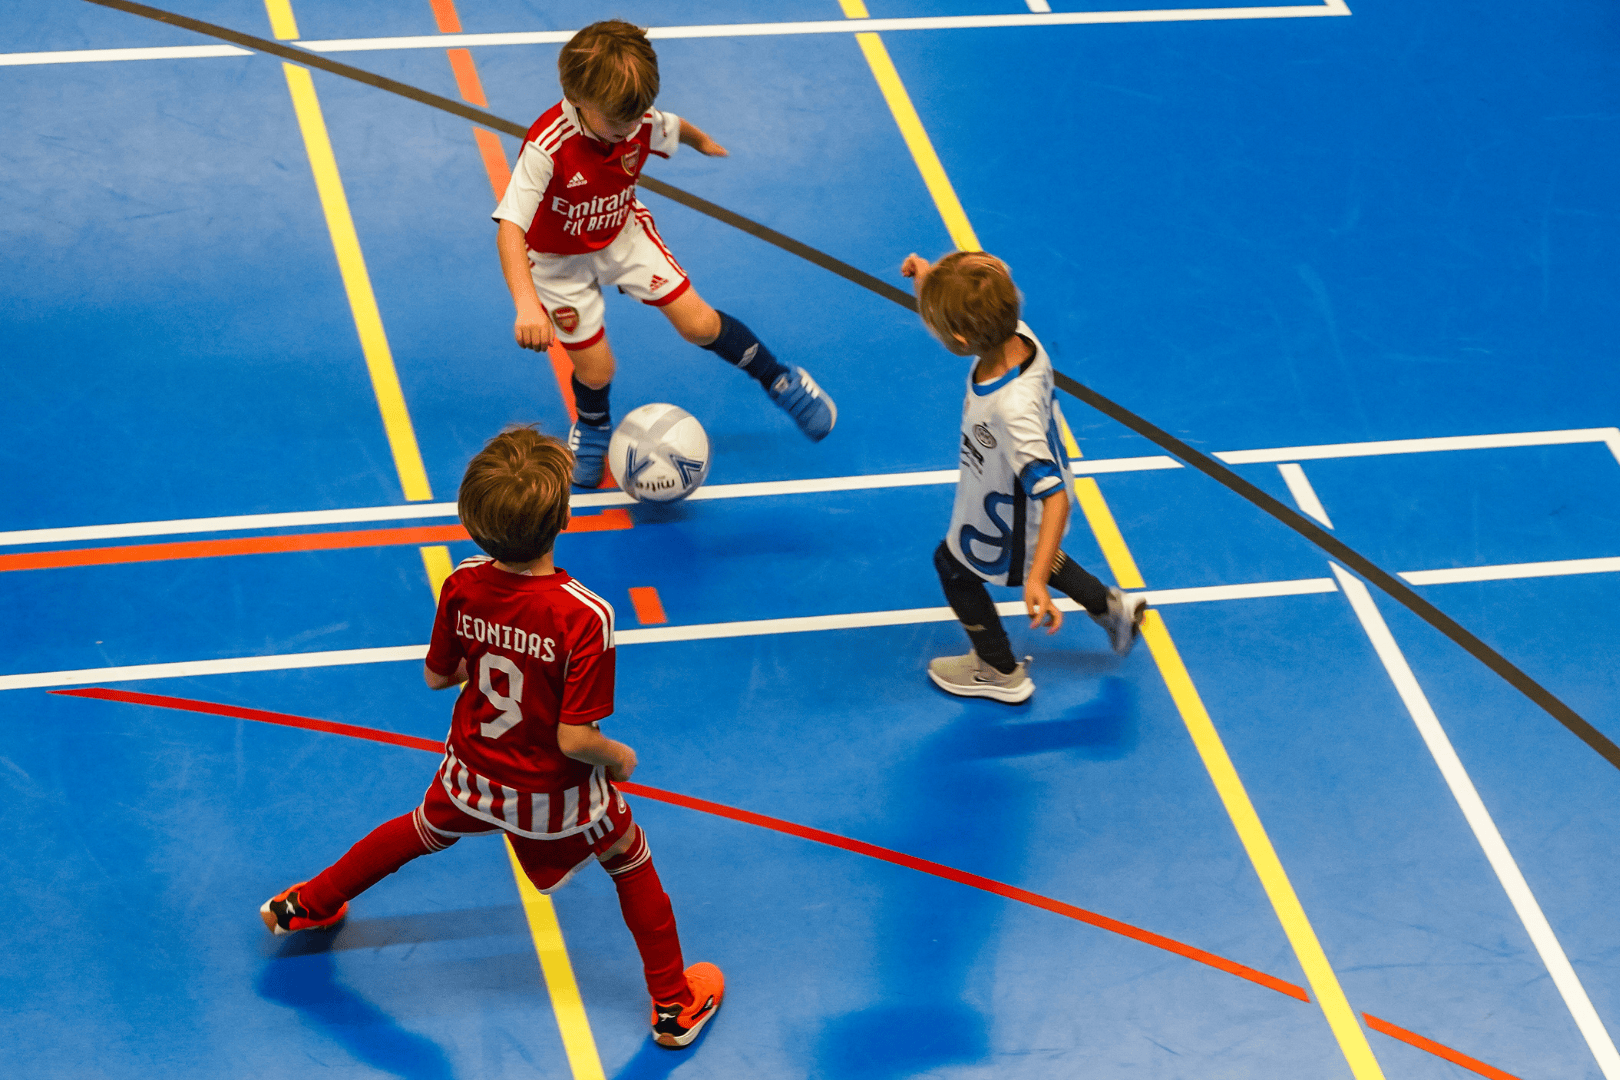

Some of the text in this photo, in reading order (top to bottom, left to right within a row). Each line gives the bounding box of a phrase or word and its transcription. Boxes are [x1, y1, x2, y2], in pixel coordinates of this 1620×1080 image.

[563, 218, 585, 236] FLY
[456, 610, 556, 662] LEONIDAS
[479, 651, 525, 740] 9
